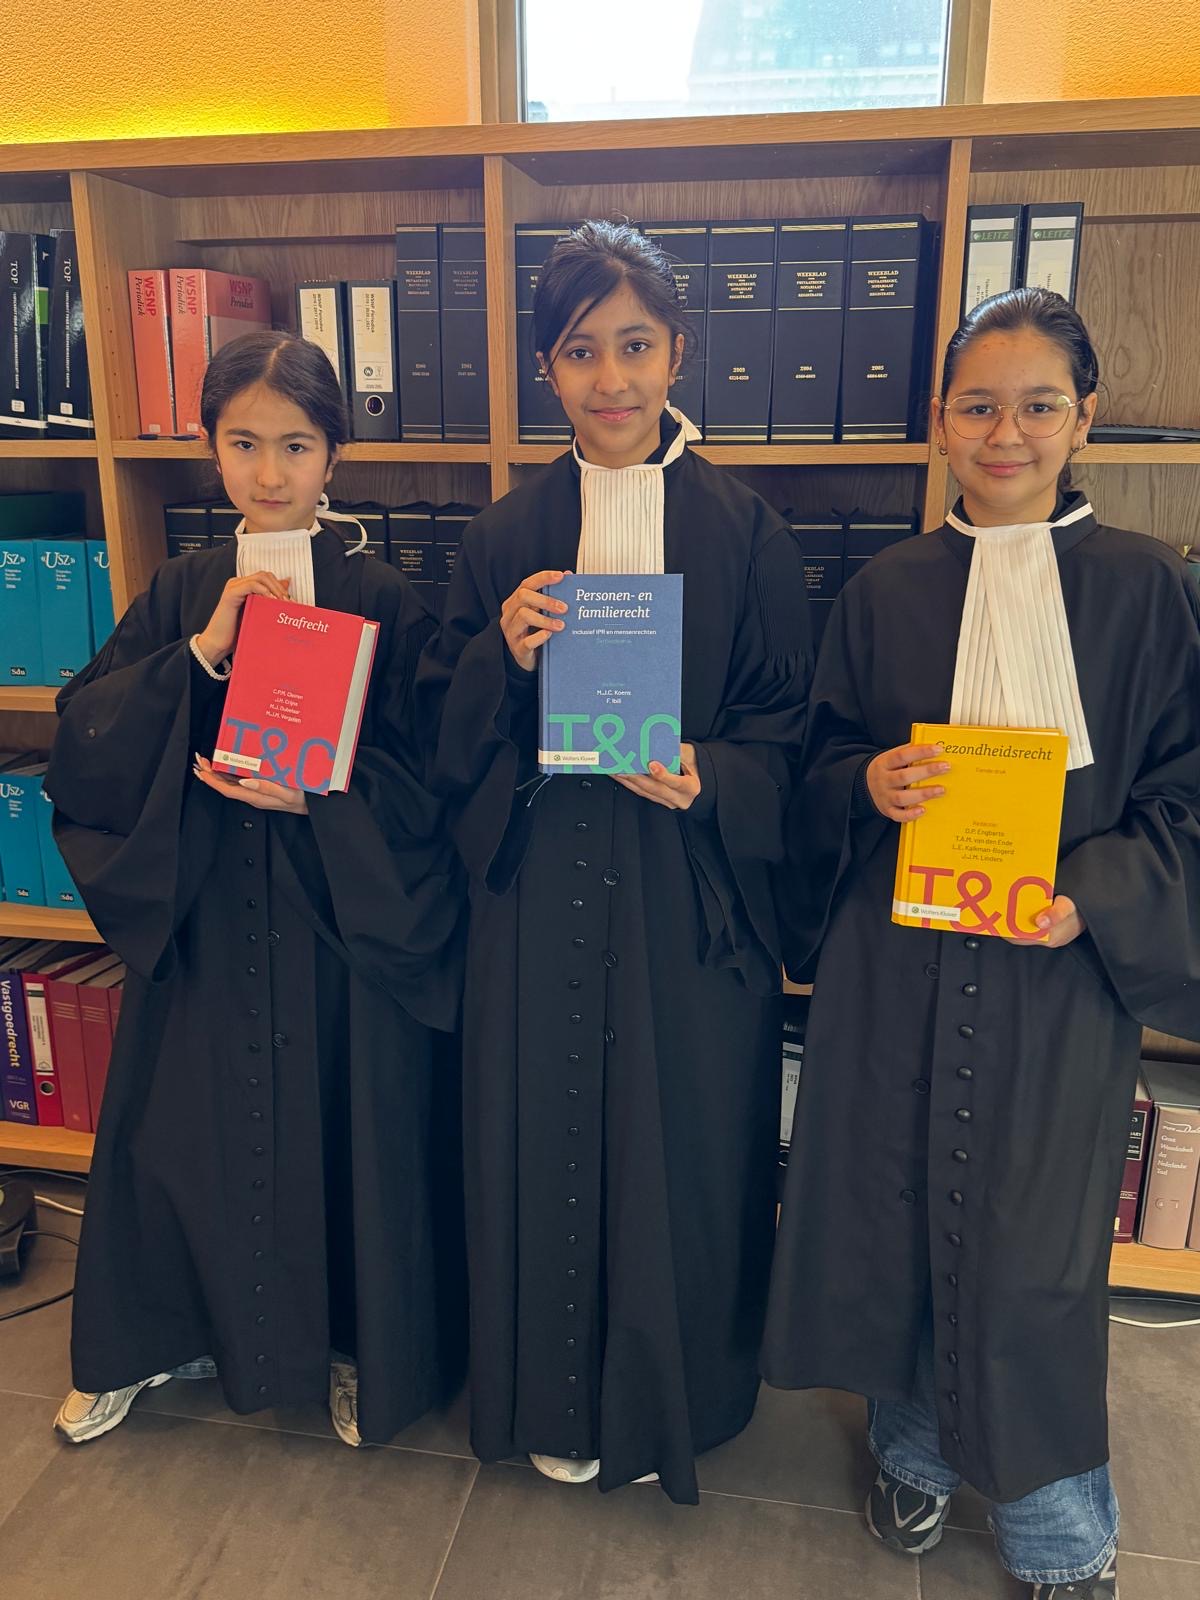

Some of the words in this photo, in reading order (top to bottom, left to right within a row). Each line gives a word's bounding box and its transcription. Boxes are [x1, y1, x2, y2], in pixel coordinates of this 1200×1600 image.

[982, 231, 1009, 240] LEITZ
[1042, 230, 1072, 239] LEITZ
[10, 261, 18, 284] TOP
[63, 259, 72, 282] TOP
[135, 276, 145, 316] Periodiek
[144, 276, 156, 316] WSNP
[176, 275, 186, 315] Periodiek
[185, 275, 197, 315] WSNP
[229, 279, 253, 295] WSNP
[575, 588, 635, 601] Personen-
[637, 591, 653, 601] en
[276, 612, 329, 633] Strafrecht
[578, 605, 651, 620] familierecht
[226, 716, 336, 793] T&C
[547, 713, 681, 774] T&C
[909, 864, 1053, 940] T&C
[920, 908, 939, 916] Wolters
[940, 910, 958, 918] Kluwer
[0, 980, 21, 1068] Vastgoedrecht
[9, 1099, 30, 1110] VGR
[1161, 1135, 1176, 1143] Groot
[1156, 1168, 1169, 1176] Taal
